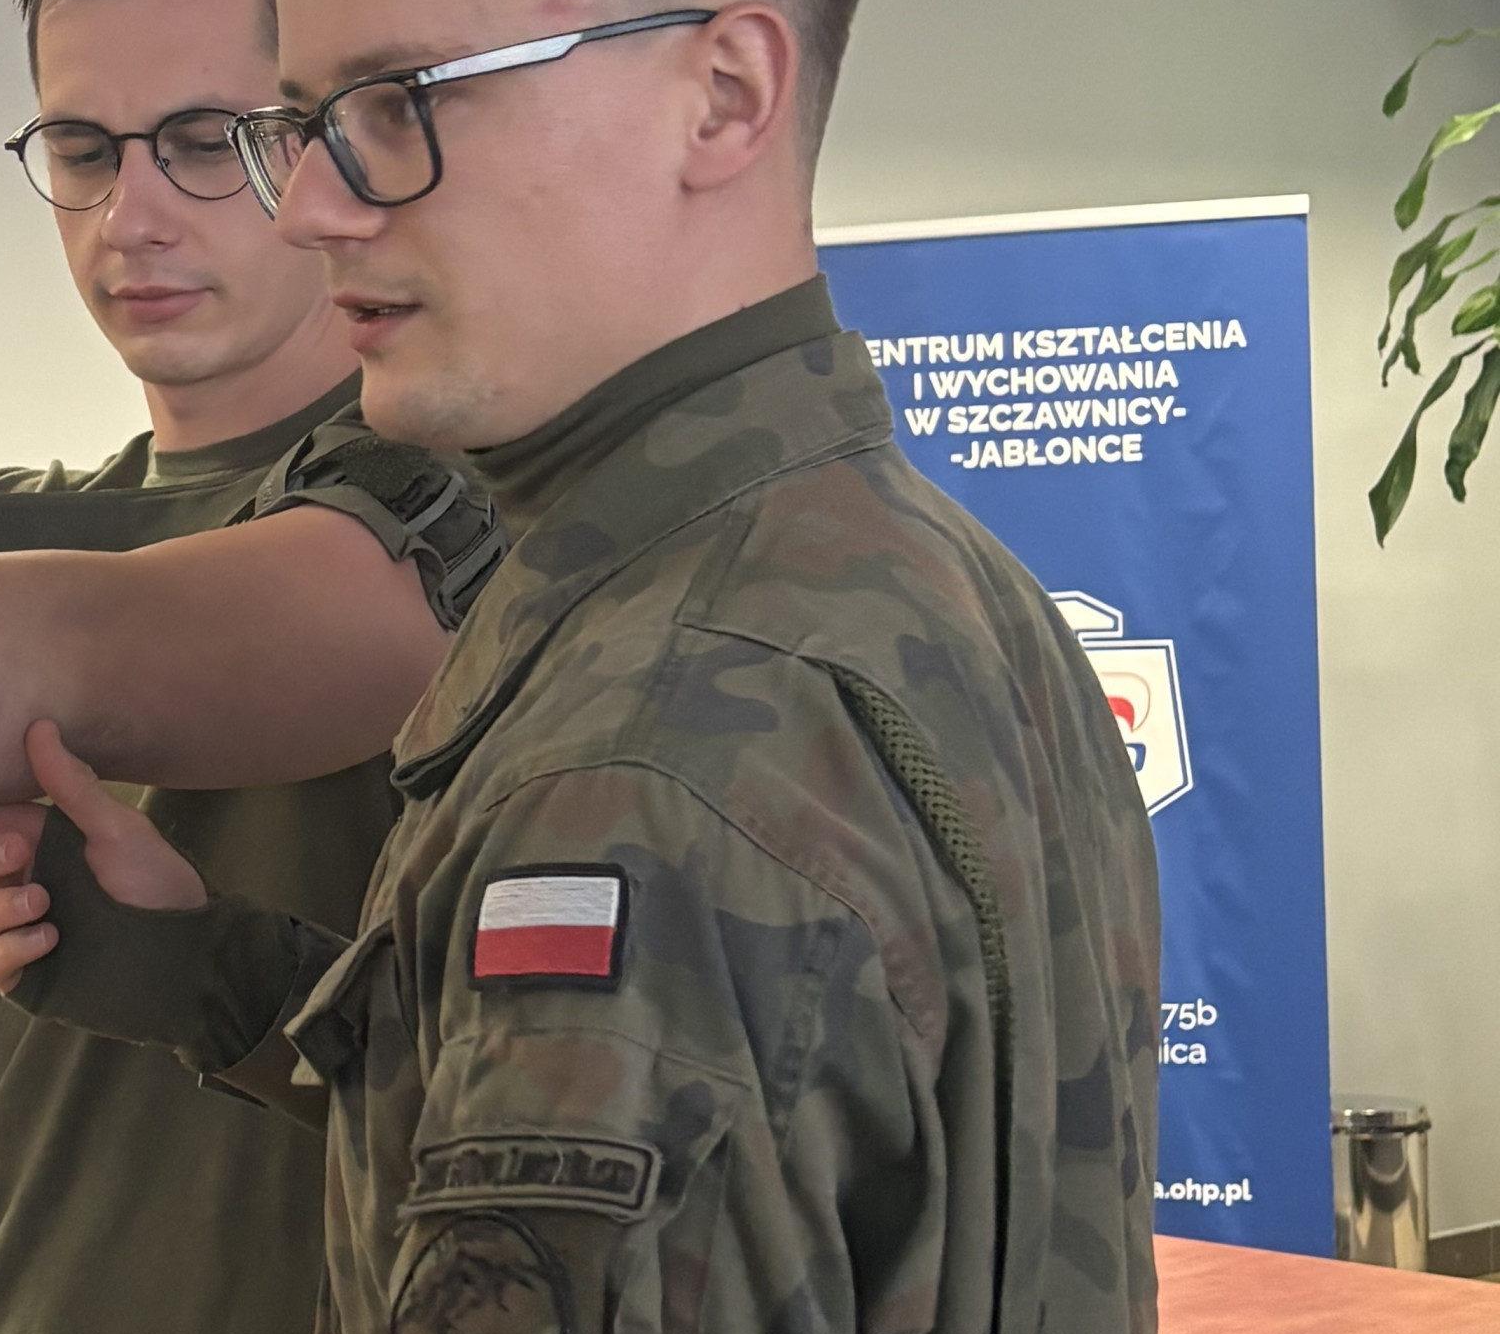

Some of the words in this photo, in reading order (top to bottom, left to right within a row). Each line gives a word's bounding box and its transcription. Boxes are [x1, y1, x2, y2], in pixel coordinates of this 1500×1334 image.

[864, 332, 1004, 368] ENTRUM
[1012, 319, 1248, 360] KSZTAŁCENIA
[912, 372, 923, 401] I
[928, 359, 1179, 400] WYCHOWANIA
[904, 406, 942, 436] W
[947, 395, 1188, 434] SZCZAWNICY-
[949, 433, 1144, 470] -JABŁONCE
[1153, 1177, 1253, 1207] a.ohp.pl
